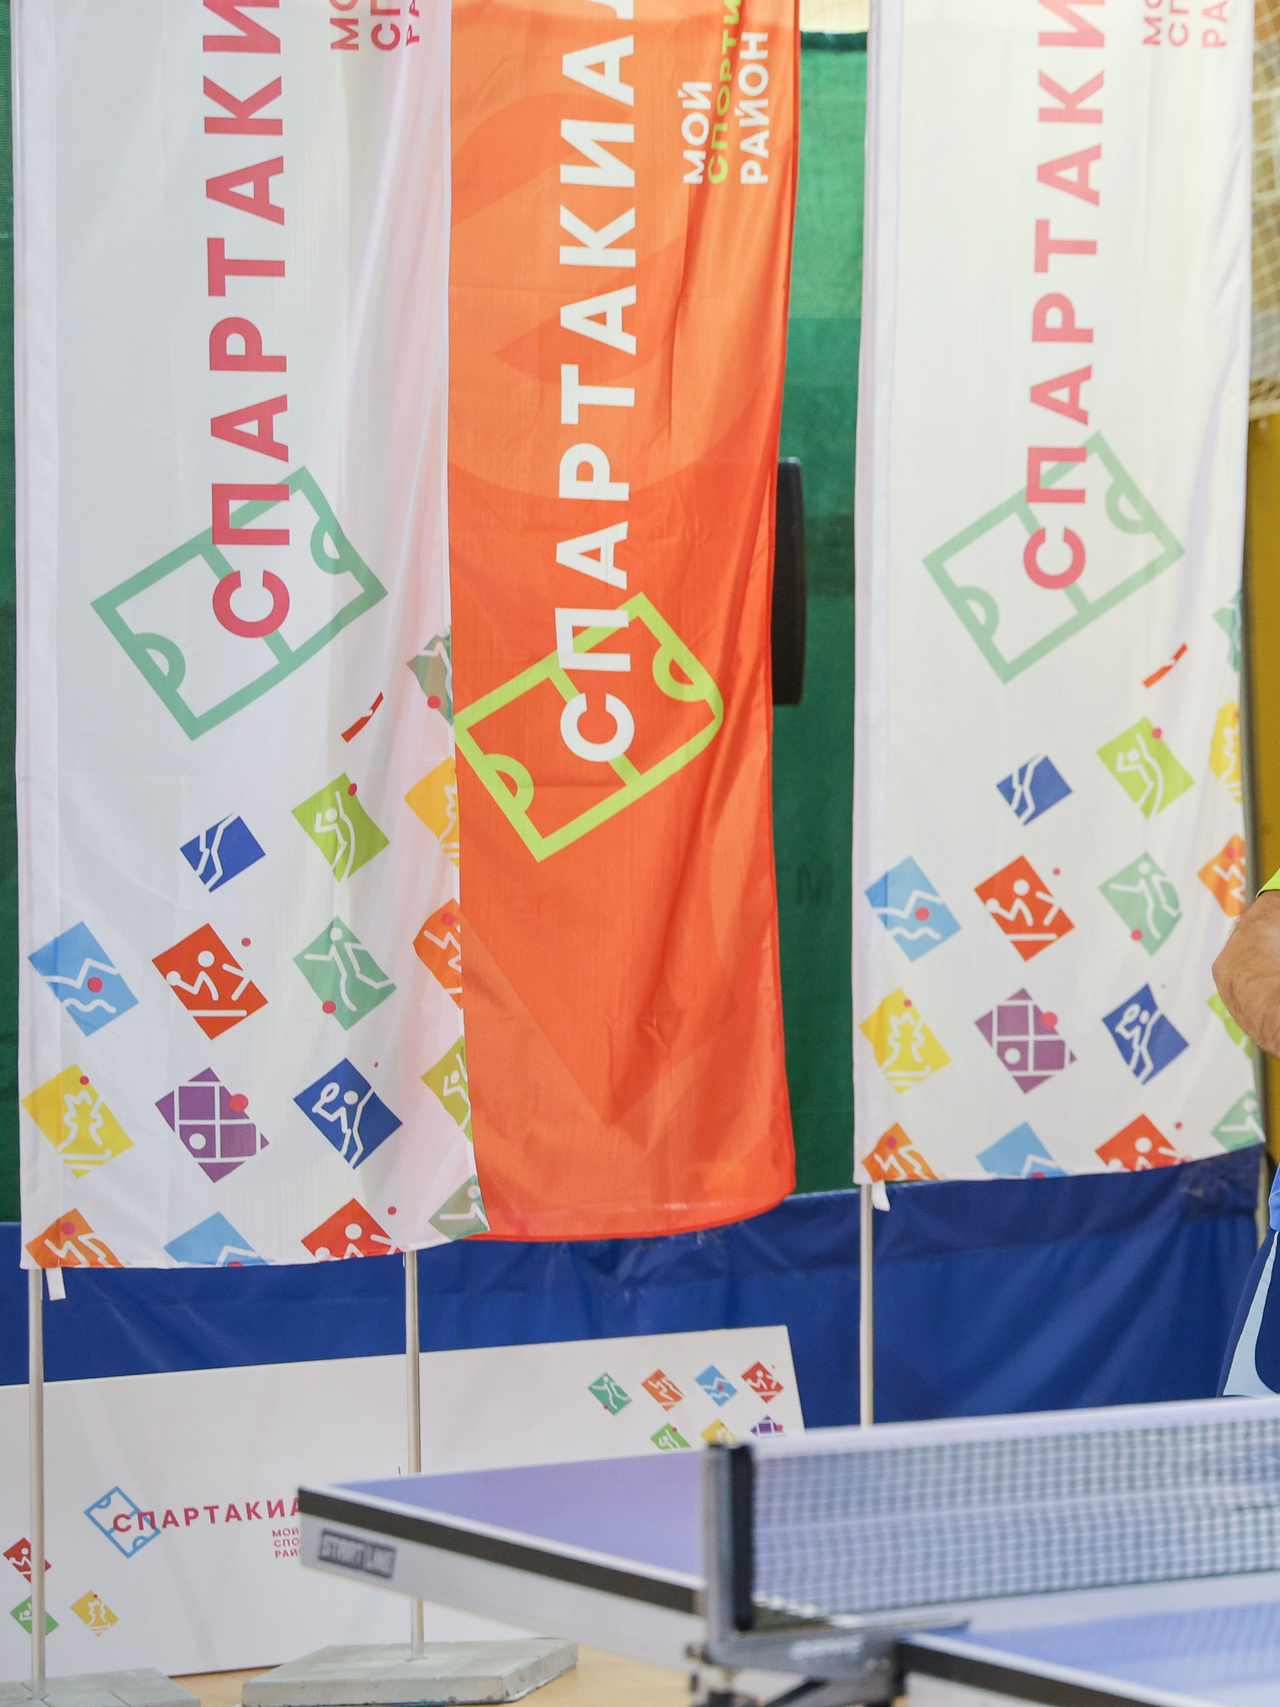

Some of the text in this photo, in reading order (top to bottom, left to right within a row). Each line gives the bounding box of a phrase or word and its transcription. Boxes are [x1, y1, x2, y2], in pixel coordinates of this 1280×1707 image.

[677, 81, 712, 184] МОЙ
[707, 0, 742, 184] СПОРТИ
[734, 32, 770, 184] РАЙОН
[555, 0, 637, 763] СПАРТАКИА
[275, 1547, 301, 1558] РАЙ
